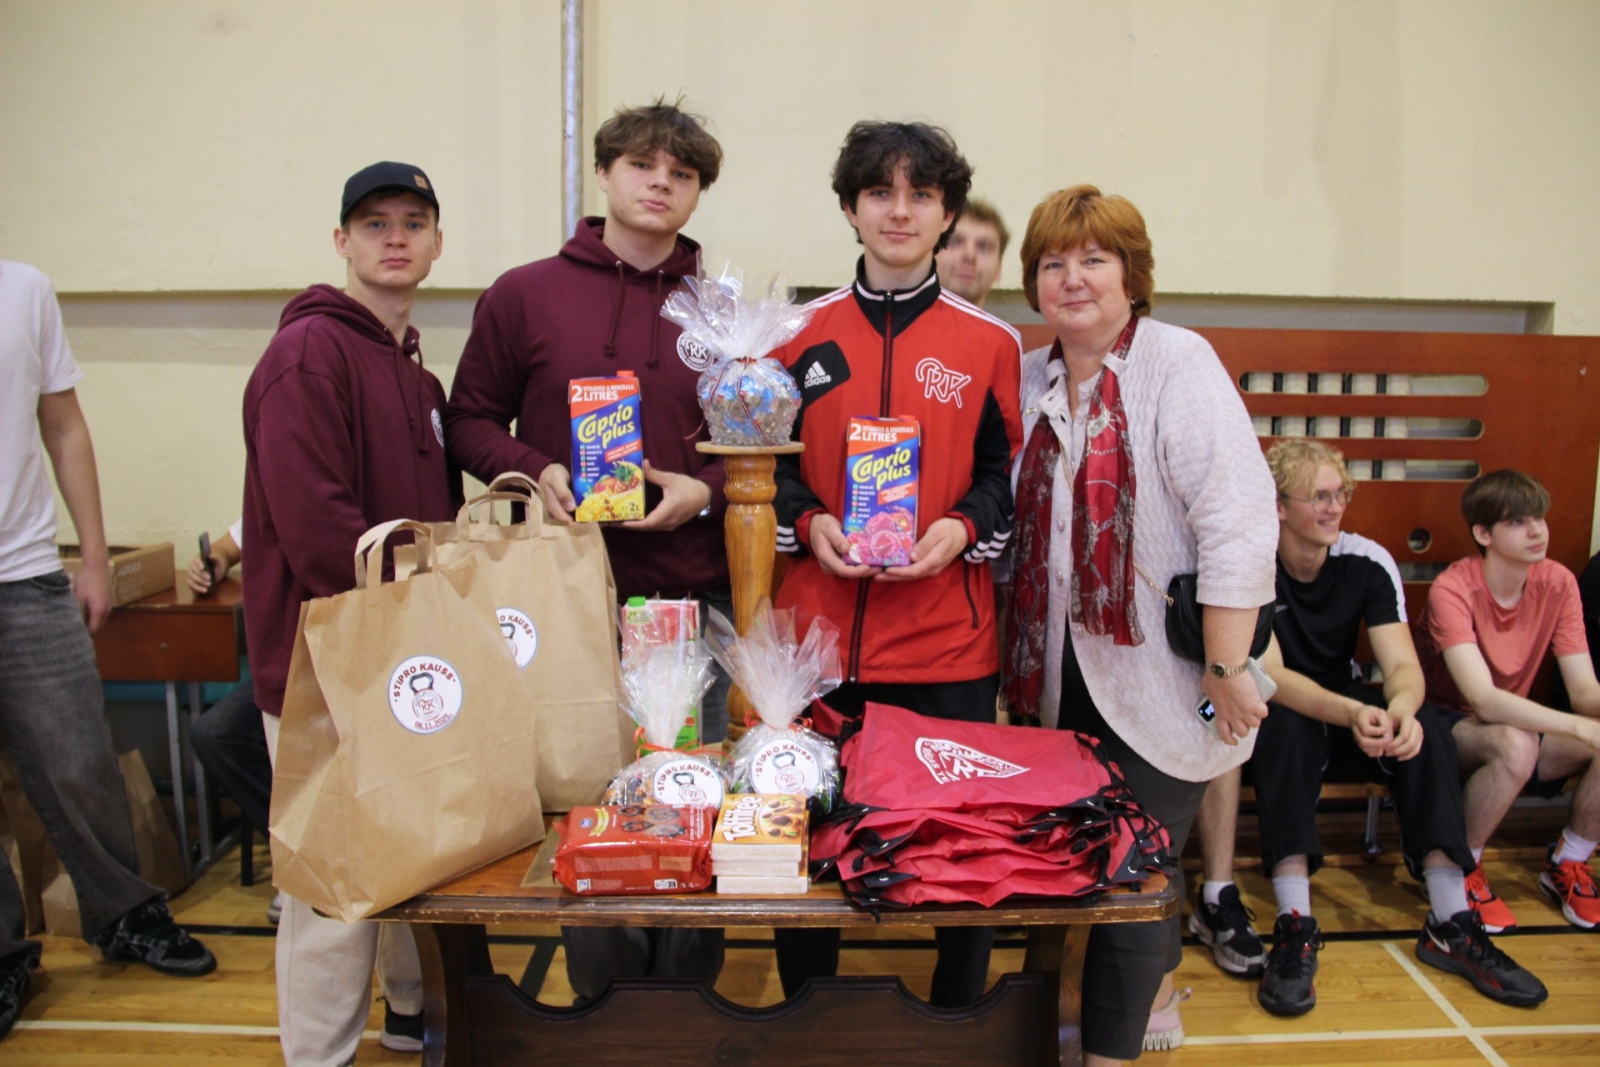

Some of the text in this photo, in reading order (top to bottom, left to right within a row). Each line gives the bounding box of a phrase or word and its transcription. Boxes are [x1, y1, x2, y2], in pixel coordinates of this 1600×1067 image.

[571, 384, 583, 403] 2
[583, 390, 619, 401] LITRES
[577, 404, 633, 443] Caprio
[602, 421, 635, 449] plus
[849, 422, 862, 441] 2
[862, 431, 898, 443] LITRES
[851, 446, 911, 483] Caprio
[876, 464, 911, 491] plus
[508, 614, 533, 635] KAUSS
[393, 663, 454, 698] STIPRO KAUSS
[755, 744, 812, 773] STIPRO KAUSS
[657, 764, 711, 792] STIPRO KAUSS
[722, 796, 764, 842] Toffifee
